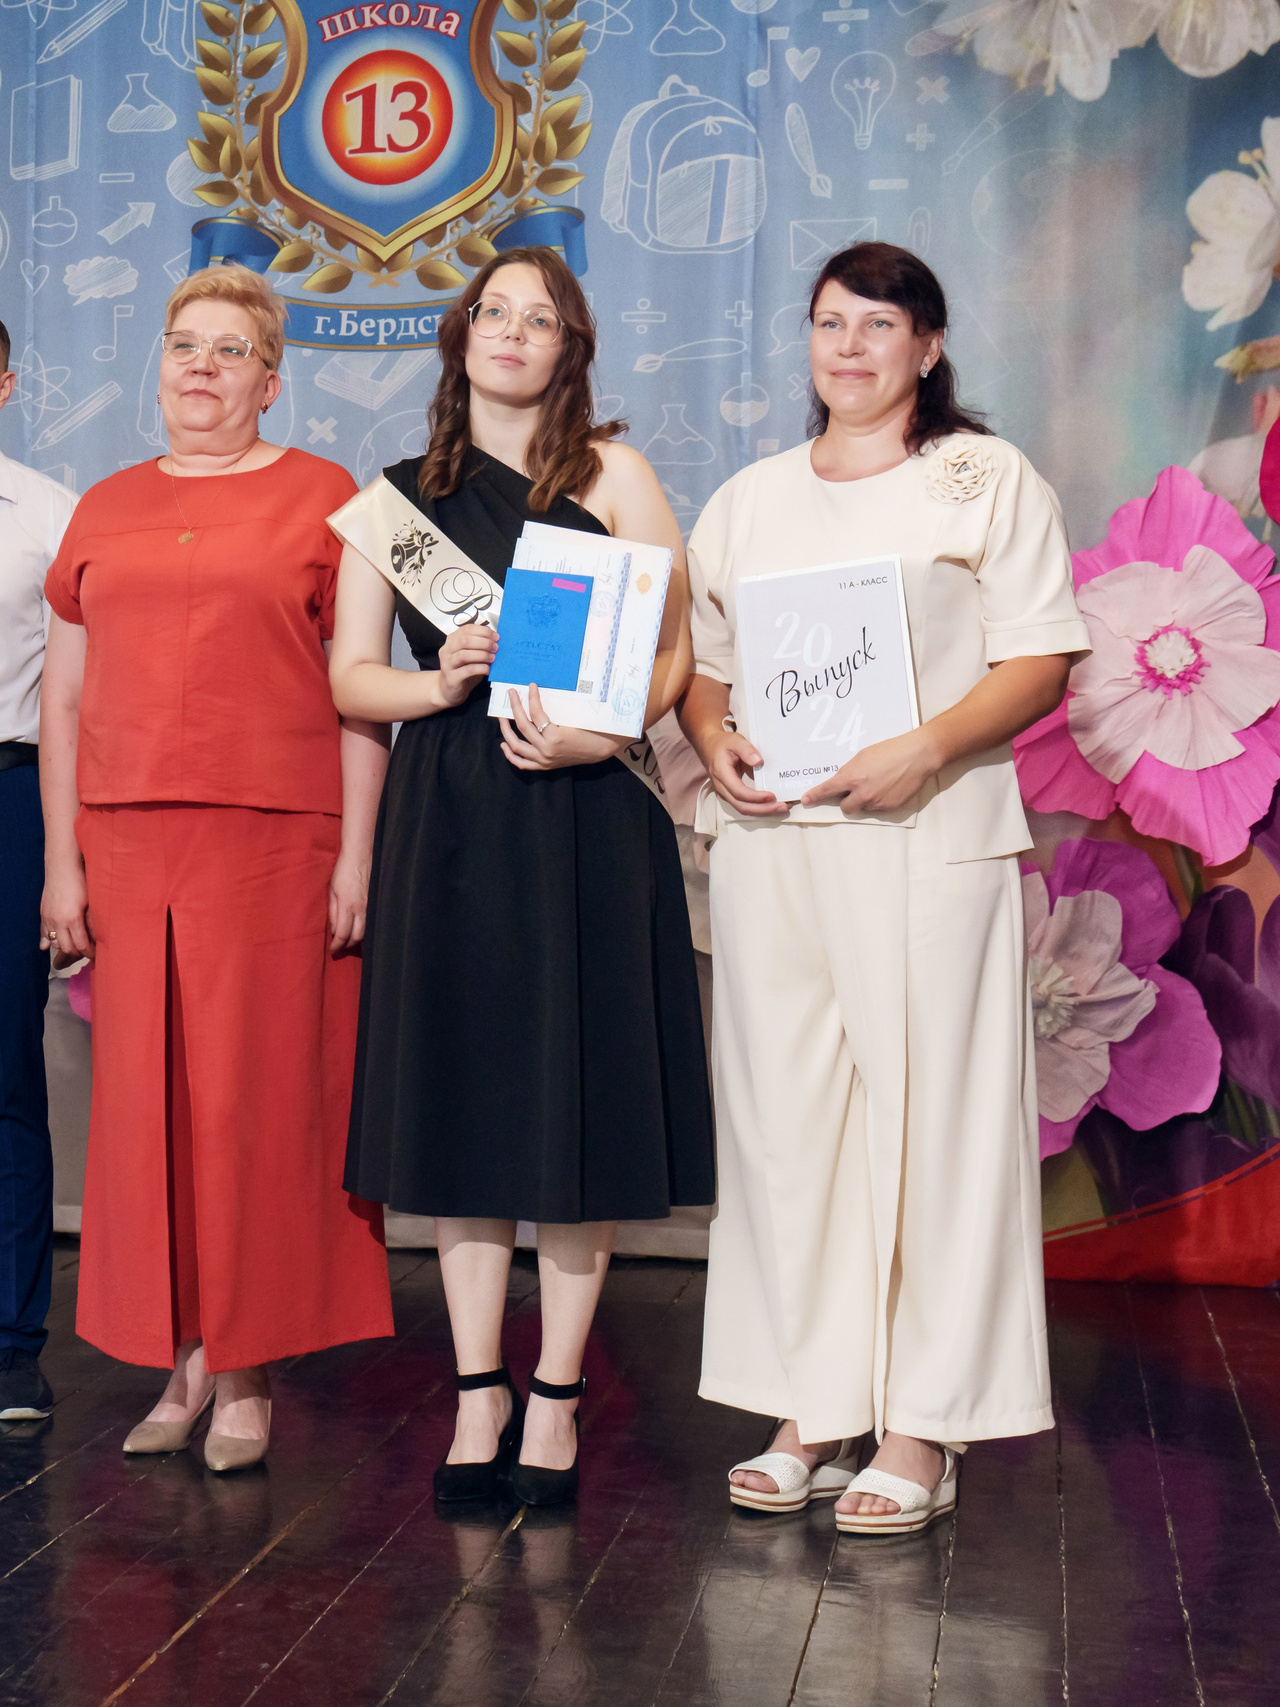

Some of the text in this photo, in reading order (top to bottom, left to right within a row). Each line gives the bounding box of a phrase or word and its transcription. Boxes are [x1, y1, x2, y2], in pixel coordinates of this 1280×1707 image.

[317, 2, 461, 43] школа
[344, 80, 432, 155] 13
[860, 576, 888, 587] КЛАСС
[765, 626, 877, 718] Выпуск
[778, 769, 801, 778] МБОУ
[802, 766, 822, 776] СОШ
